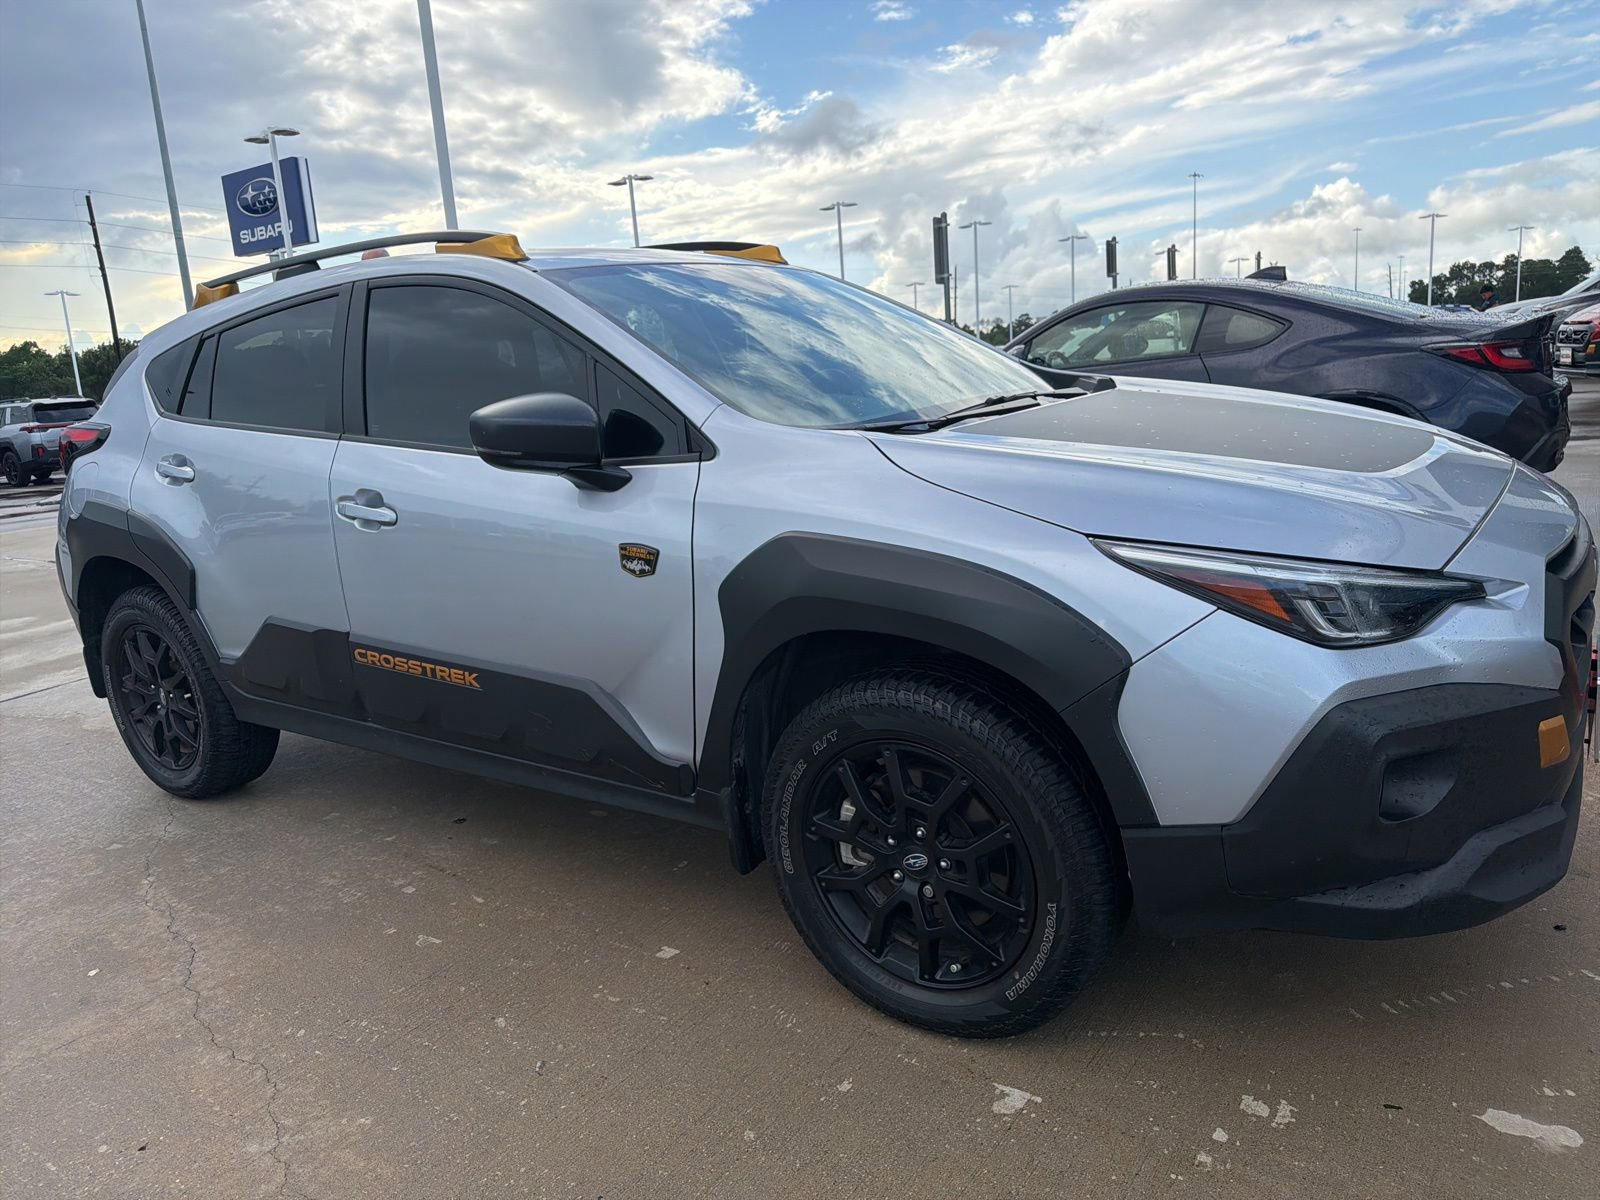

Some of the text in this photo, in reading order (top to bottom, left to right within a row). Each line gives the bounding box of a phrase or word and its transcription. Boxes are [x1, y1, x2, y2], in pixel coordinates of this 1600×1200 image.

[354, 648, 480, 688] CROSSTREK
[779, 729, 838, 874] GEOLANDAR A/T
[1005, 903, 1057, 1001] YOKOHAMA
